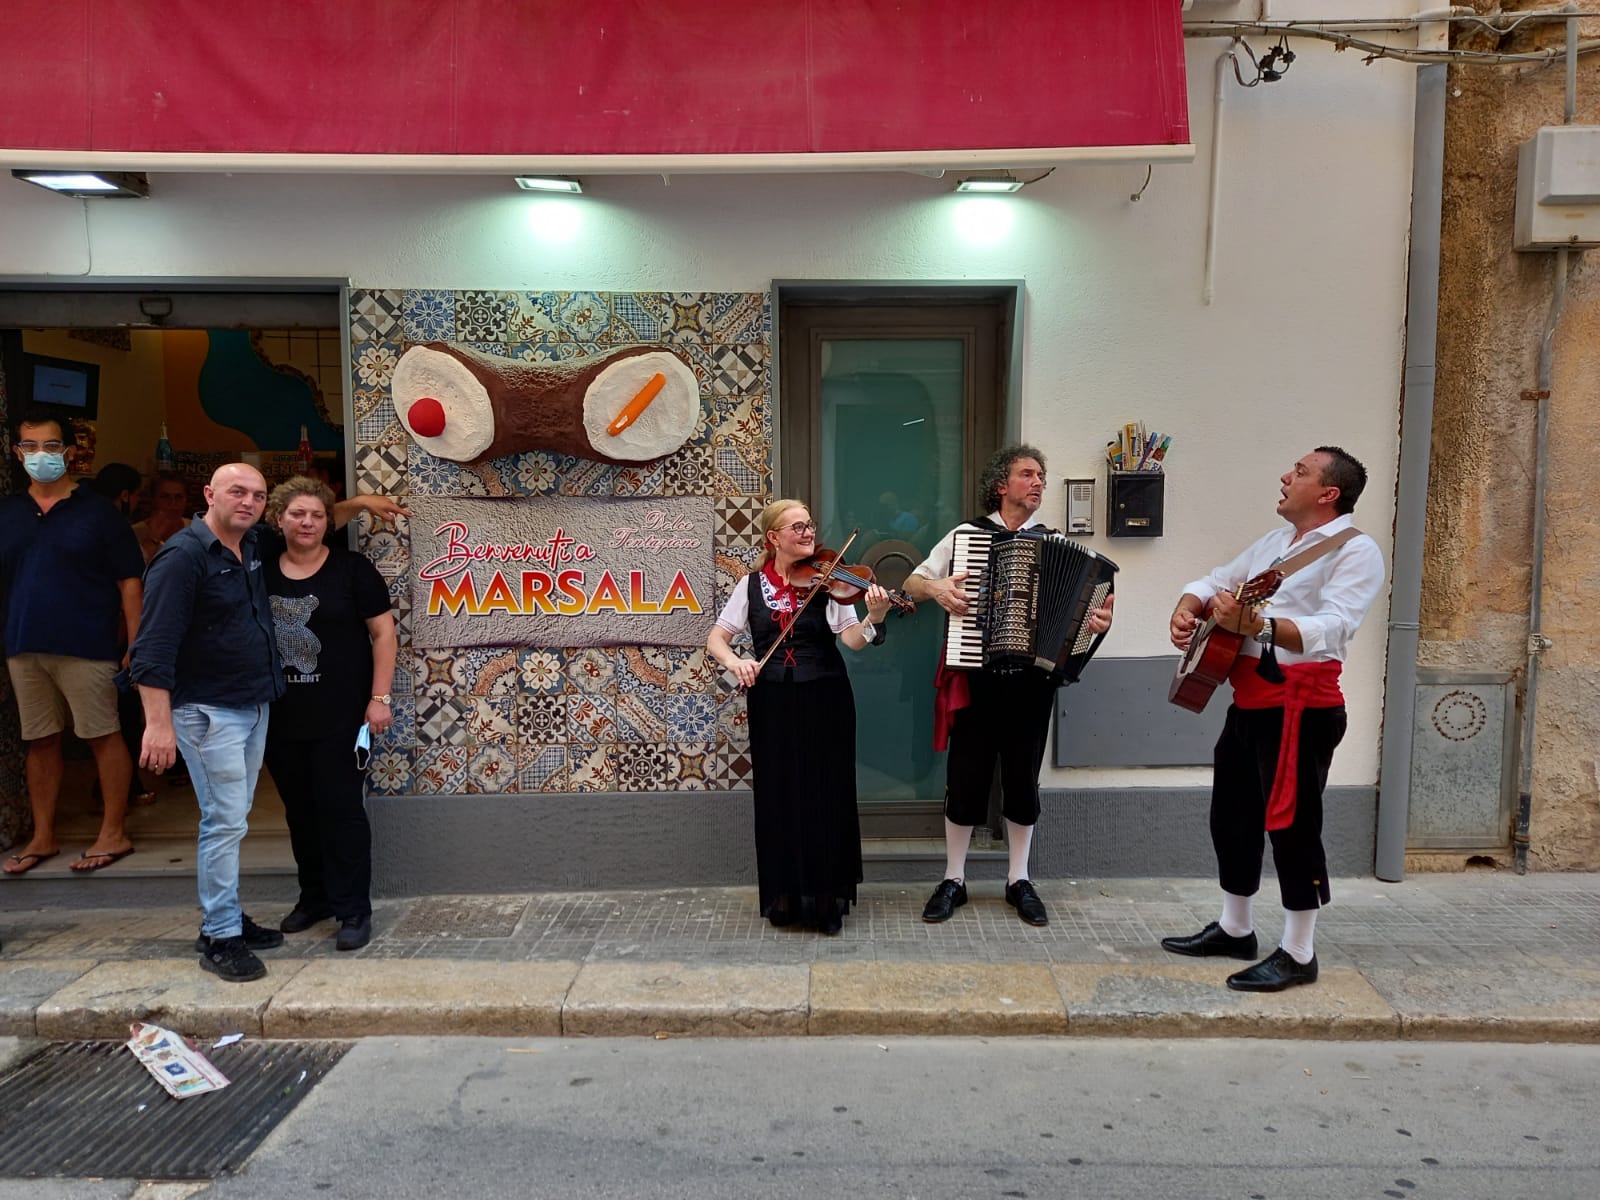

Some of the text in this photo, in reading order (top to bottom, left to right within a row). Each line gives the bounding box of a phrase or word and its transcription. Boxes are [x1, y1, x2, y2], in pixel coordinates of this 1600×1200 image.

[641, 510, 695, 532] Dolce
[419, 521, 595, 581] Benvenuti a
[609, 527, 701, 555] Tentazione
[426, 569, 703, 616] MARSALA
[1030, 572, 1040, 620] SCANDALLI
[287, 673, 322, 684] LLENT
